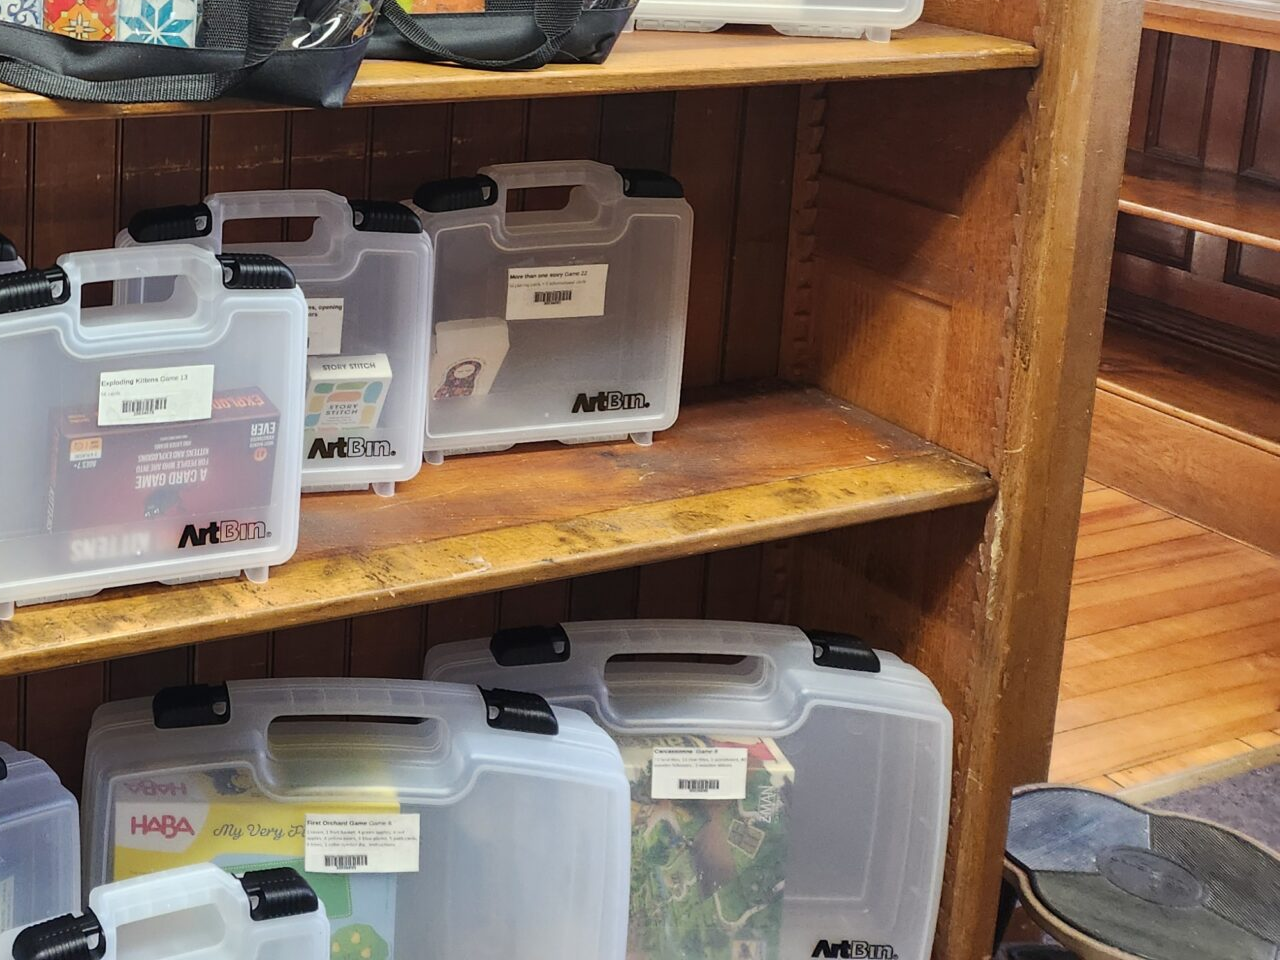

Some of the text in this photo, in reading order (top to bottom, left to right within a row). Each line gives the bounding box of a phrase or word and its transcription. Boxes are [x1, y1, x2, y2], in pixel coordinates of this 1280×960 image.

[322, 361, 377, 371] STORY STITCH
[101, 378, 134, 387] Exploding
[135, 376, 159, 384] Kittens
[250, 421, 276, 436] EVER
[134, 468, 208, 489] A CARD GAME
[130, 815, 196, 839] HABA
[213, 822, 244, 842] My
[248, 823, 286, 841] Very
